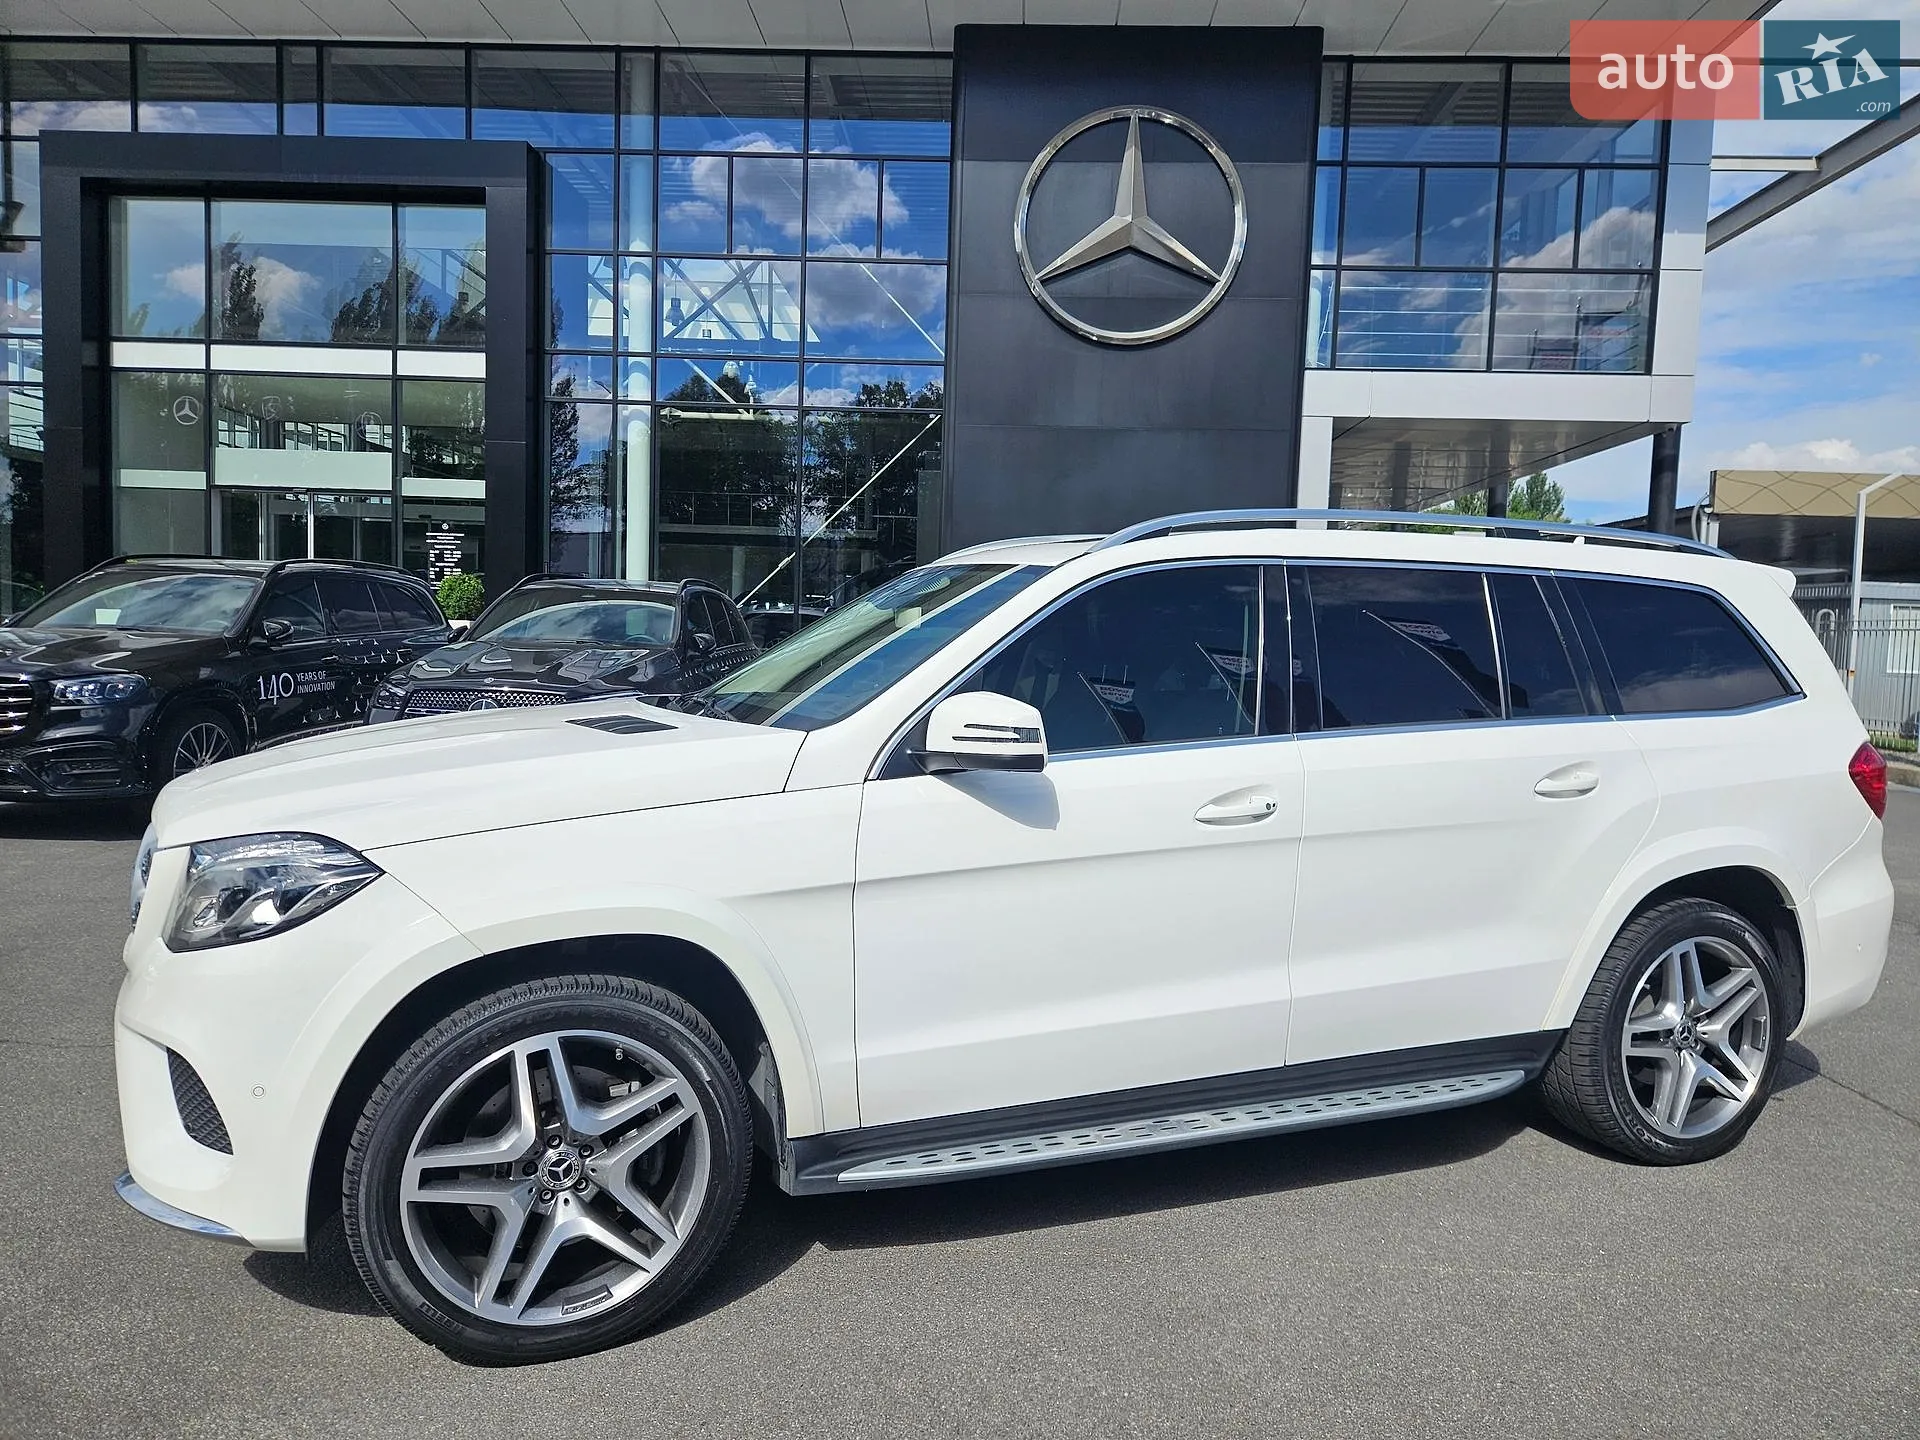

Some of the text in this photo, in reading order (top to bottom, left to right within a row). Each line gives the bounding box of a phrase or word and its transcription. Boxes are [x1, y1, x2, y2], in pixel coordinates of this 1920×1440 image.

[296, 670, 327, 682] YEARS OF
[257, 672, 294, 705] 140
[297, 681, 336, 694] INNOVATION
